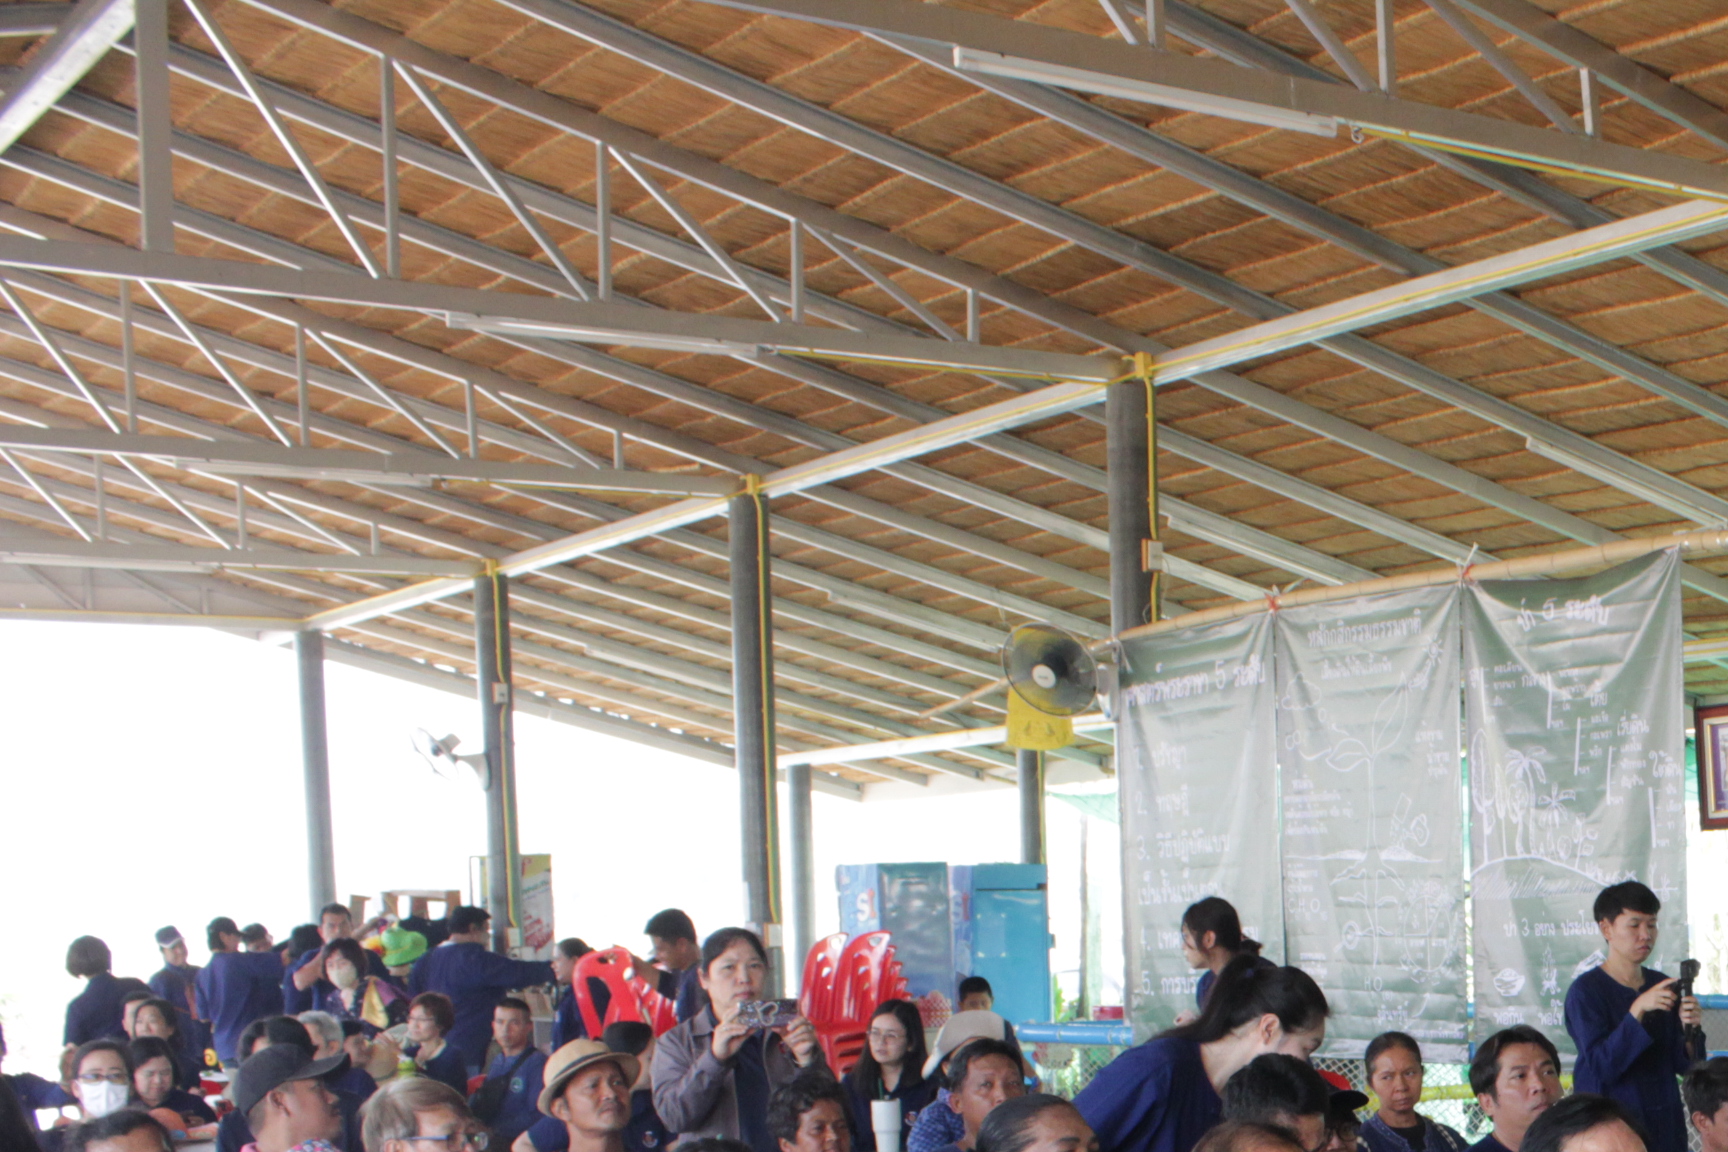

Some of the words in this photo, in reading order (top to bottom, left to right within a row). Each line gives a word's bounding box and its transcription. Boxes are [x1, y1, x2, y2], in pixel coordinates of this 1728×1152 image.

[1215, 659, 1225, 690] 5
[1233, 653, 1266, 688] ระดับ
[1136, 836, 1150, 860] 3.
[1522, 918, 1530, 937] 3
[1141, 970, 1155, 996] 5.
